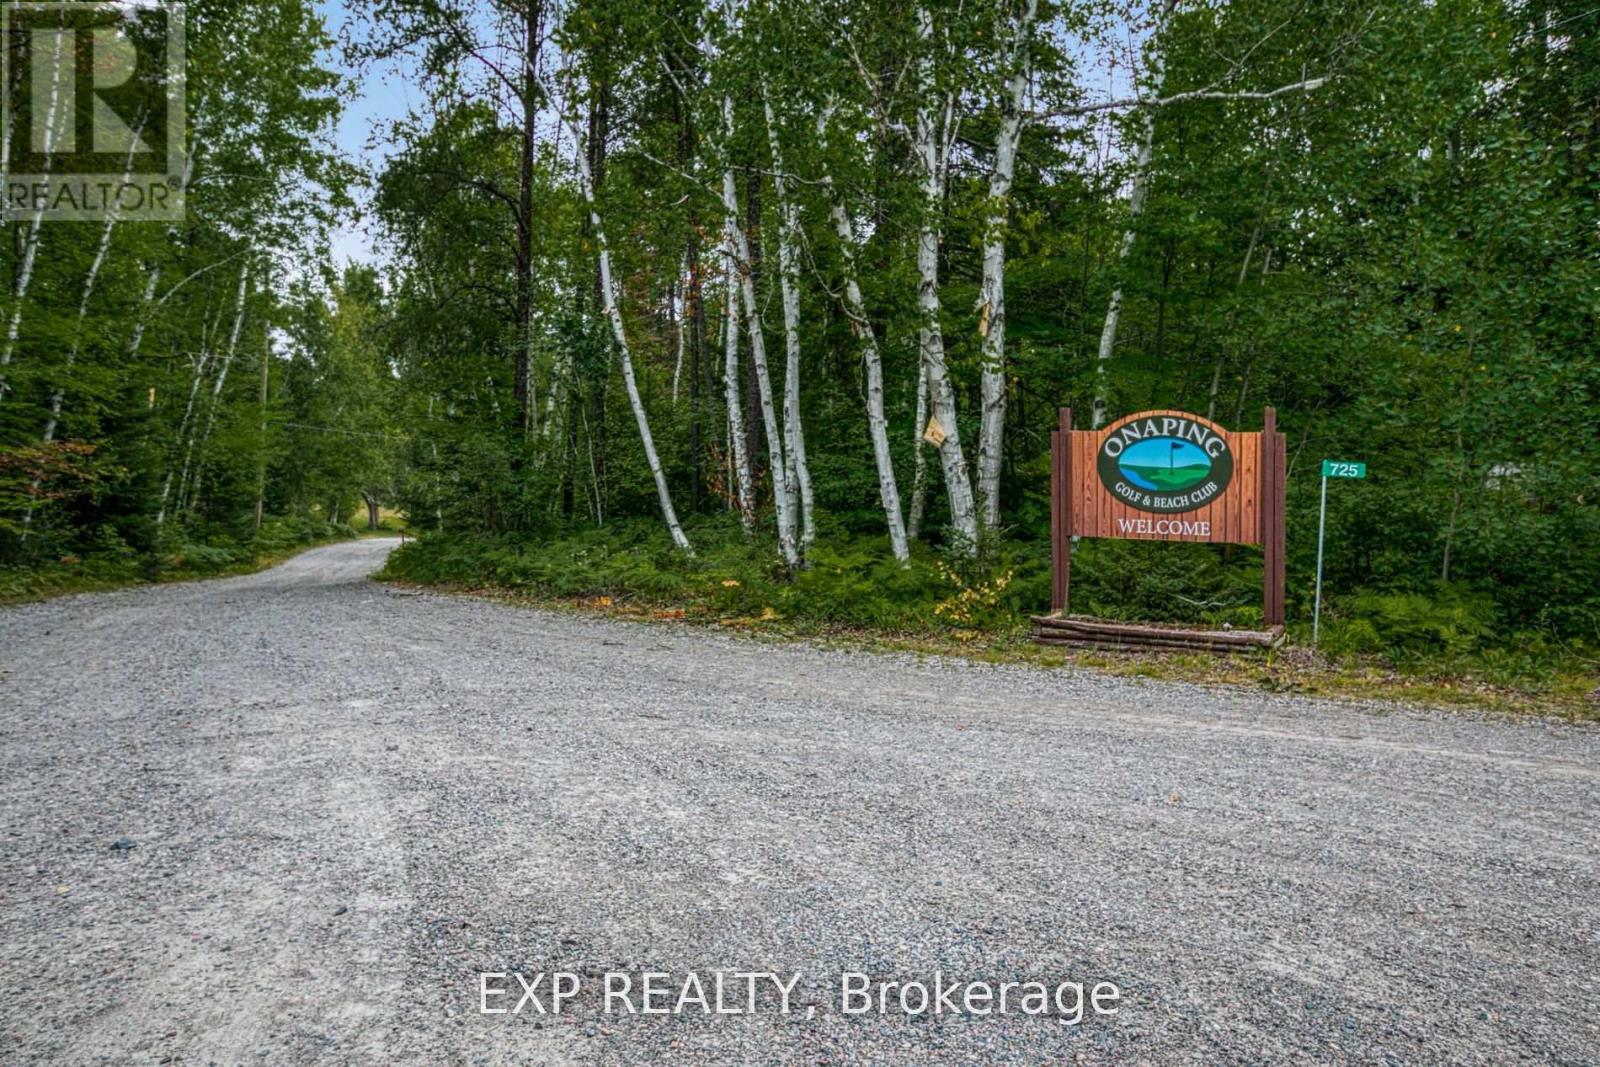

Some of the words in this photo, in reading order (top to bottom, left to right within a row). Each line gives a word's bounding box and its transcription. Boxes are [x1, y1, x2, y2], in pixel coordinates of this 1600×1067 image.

[1104, 417, 1226, 459] ONAPING
[1330, 463, 1358, 477] 725
[1115, 481, 1142, 504] GOLF
[1143, 495, 1151, 506] &
[1153, 494, 1189, 508] BEACH
[1191, 481, 1218, 503] CLUB
[1119, 518, 1211, 536] WELCOME
